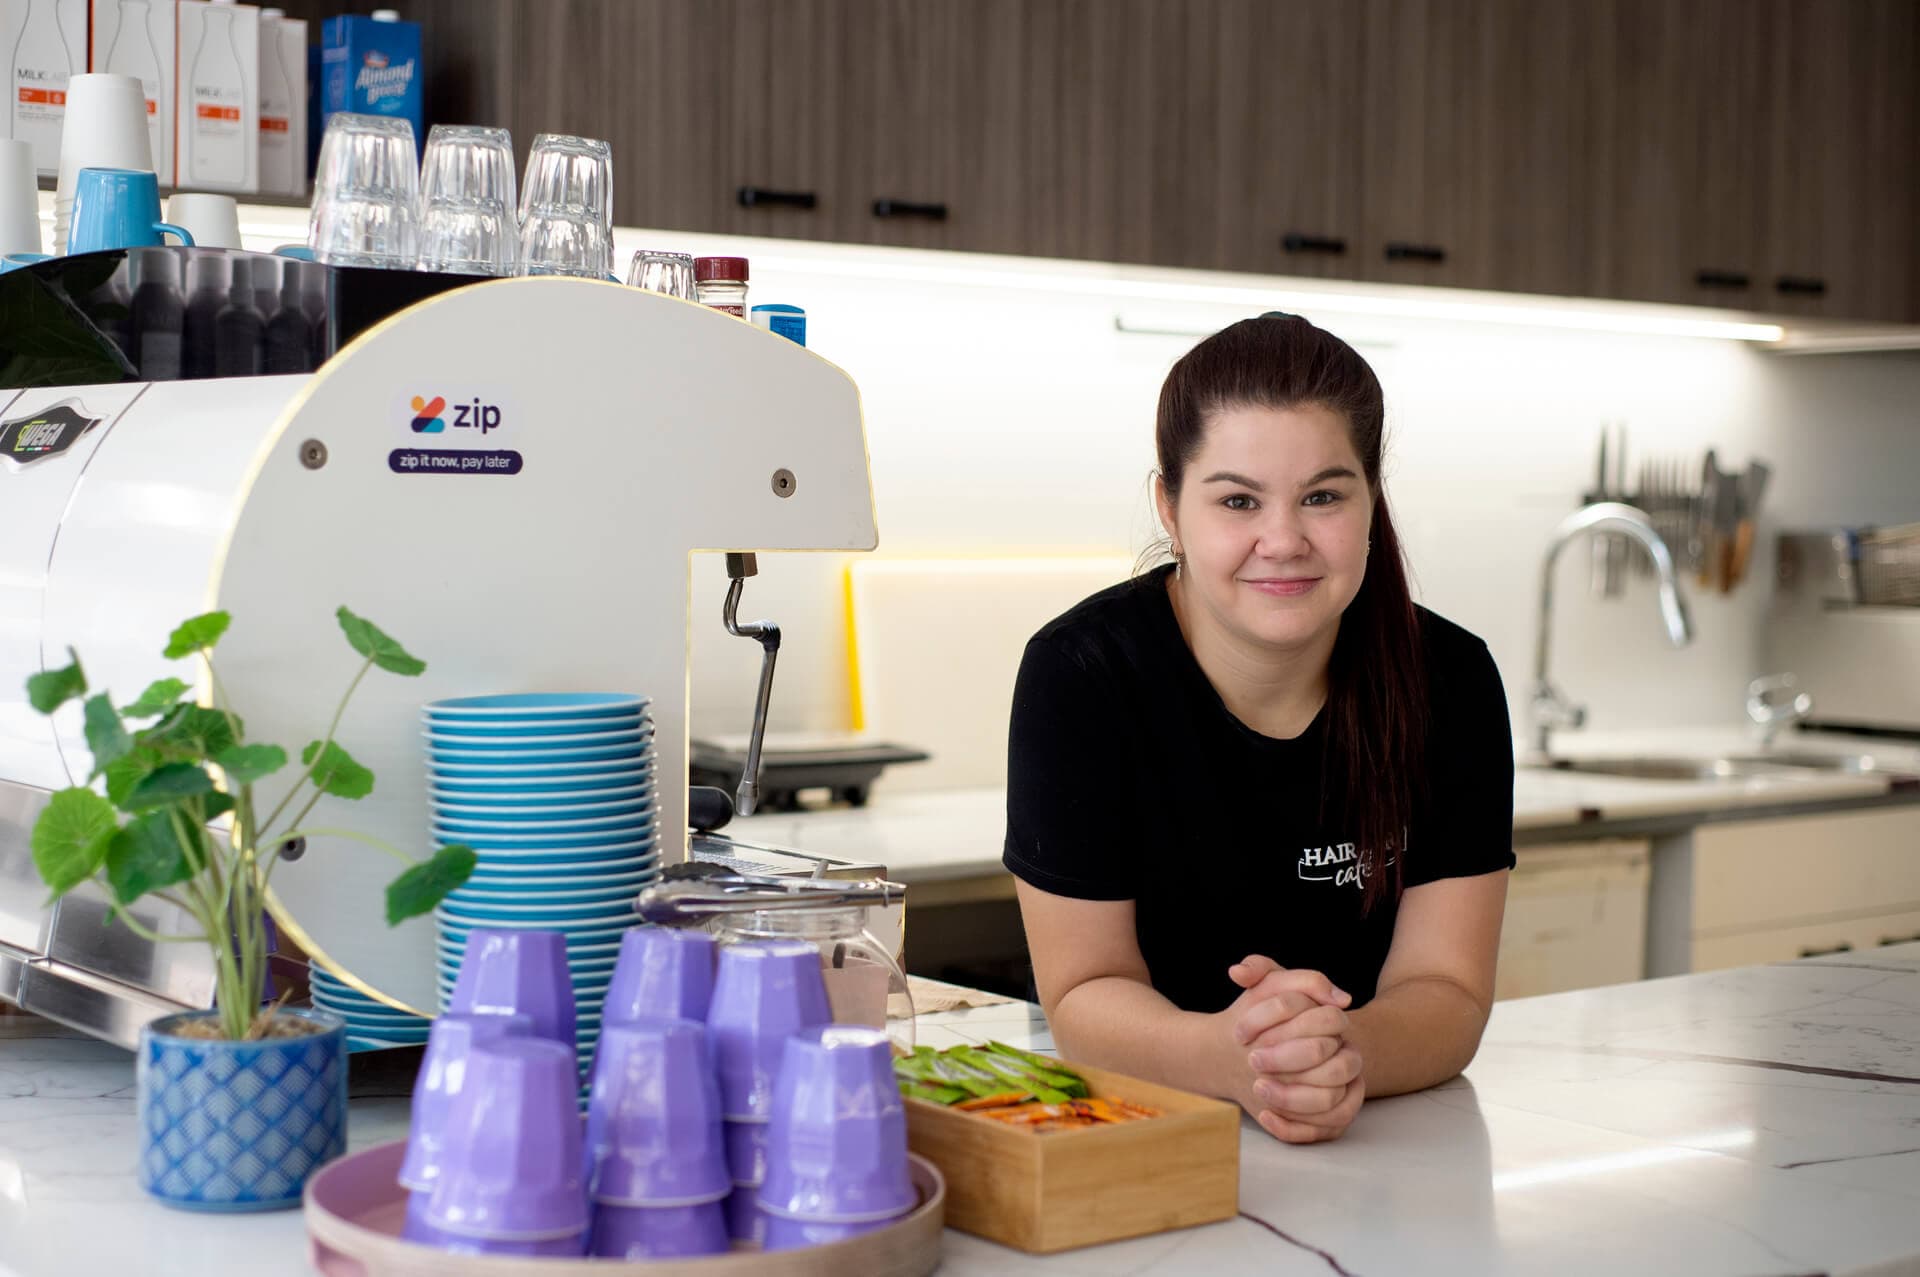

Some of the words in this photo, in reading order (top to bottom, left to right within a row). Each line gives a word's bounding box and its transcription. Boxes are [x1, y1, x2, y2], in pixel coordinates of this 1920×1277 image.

[453, 397, 500, 434] zip
[400, 454, 419, 469] zip
[420, 454, 430, 467] it
[462, 457, 483, 470] pay
[485, 455, 511, 468] later
[1304, 843, 1358, 866] HAIR
